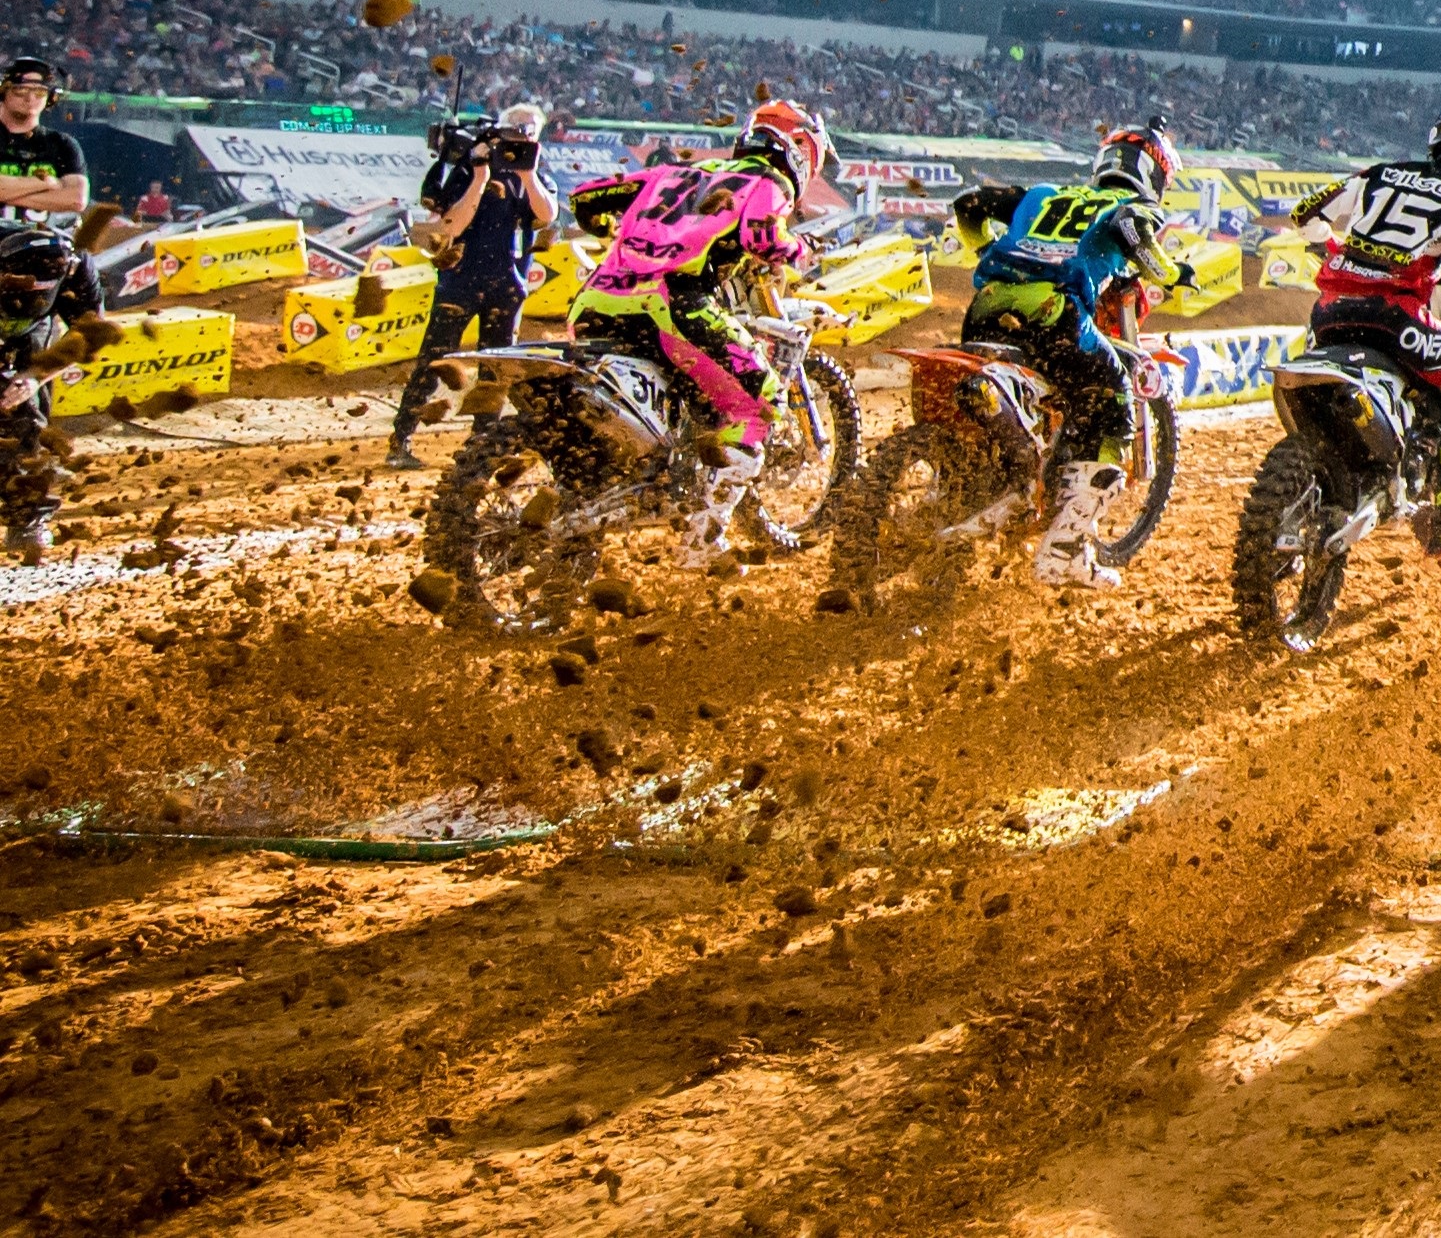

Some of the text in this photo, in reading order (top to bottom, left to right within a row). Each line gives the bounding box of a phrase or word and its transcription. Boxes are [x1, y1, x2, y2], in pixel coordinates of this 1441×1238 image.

[336, 123, 352, 134] UP
[356, 123, 387, 135] NEXT
[263, 145, 425, 168] Husqvarna
[845, 163, 962, 183] AMSOIL
[883, 200, 948, 215] AMS
[1028, 194, 1116, 241] 18
[221, 242, 299, 263] DUNLOP
[374, 311, 431, 334] DUN
[95, 349, 228, 381] DUNLOP
